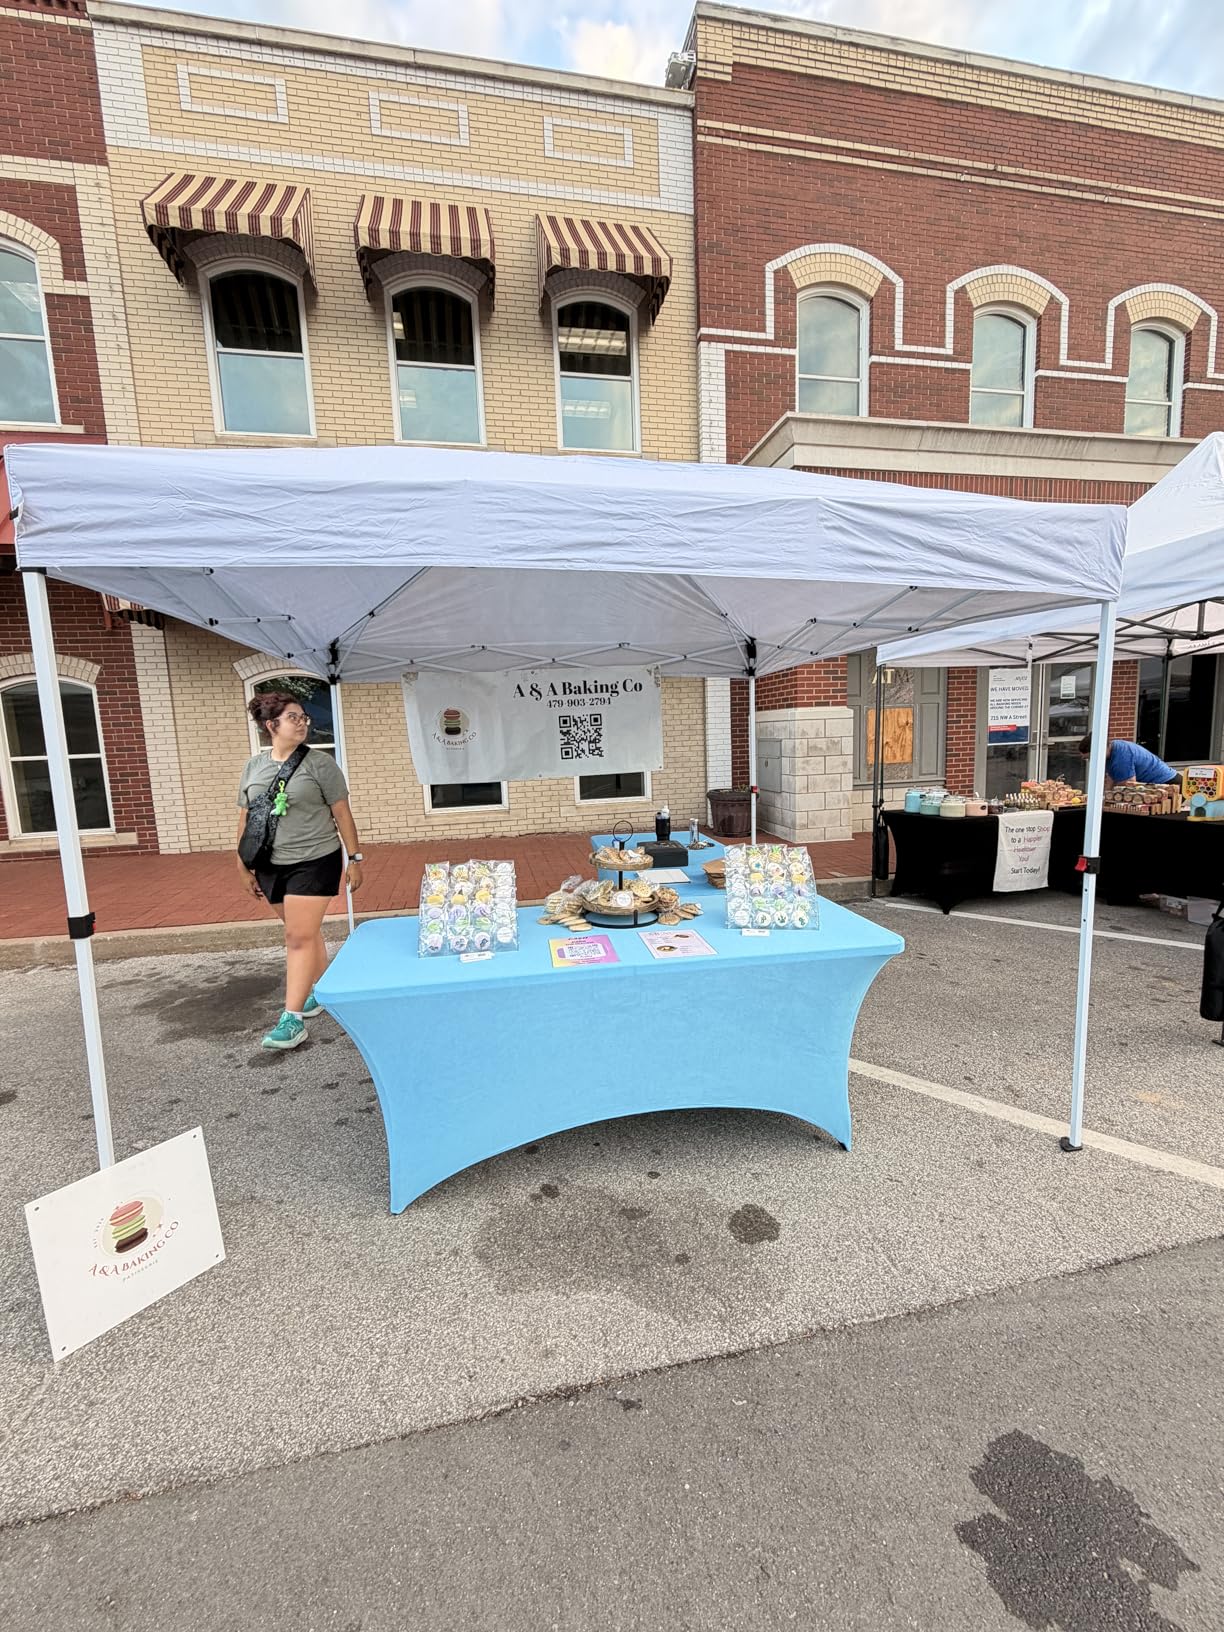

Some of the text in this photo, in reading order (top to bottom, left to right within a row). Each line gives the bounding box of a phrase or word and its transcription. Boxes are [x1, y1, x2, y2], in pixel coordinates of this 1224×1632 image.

[513, 678, 643, 701] A & A Baking Co
[546, 697, 612, 709] 479-903-2794
[121, 1239, 166, 1272] BAKING
[164, 1221, 179, 1239] CO
